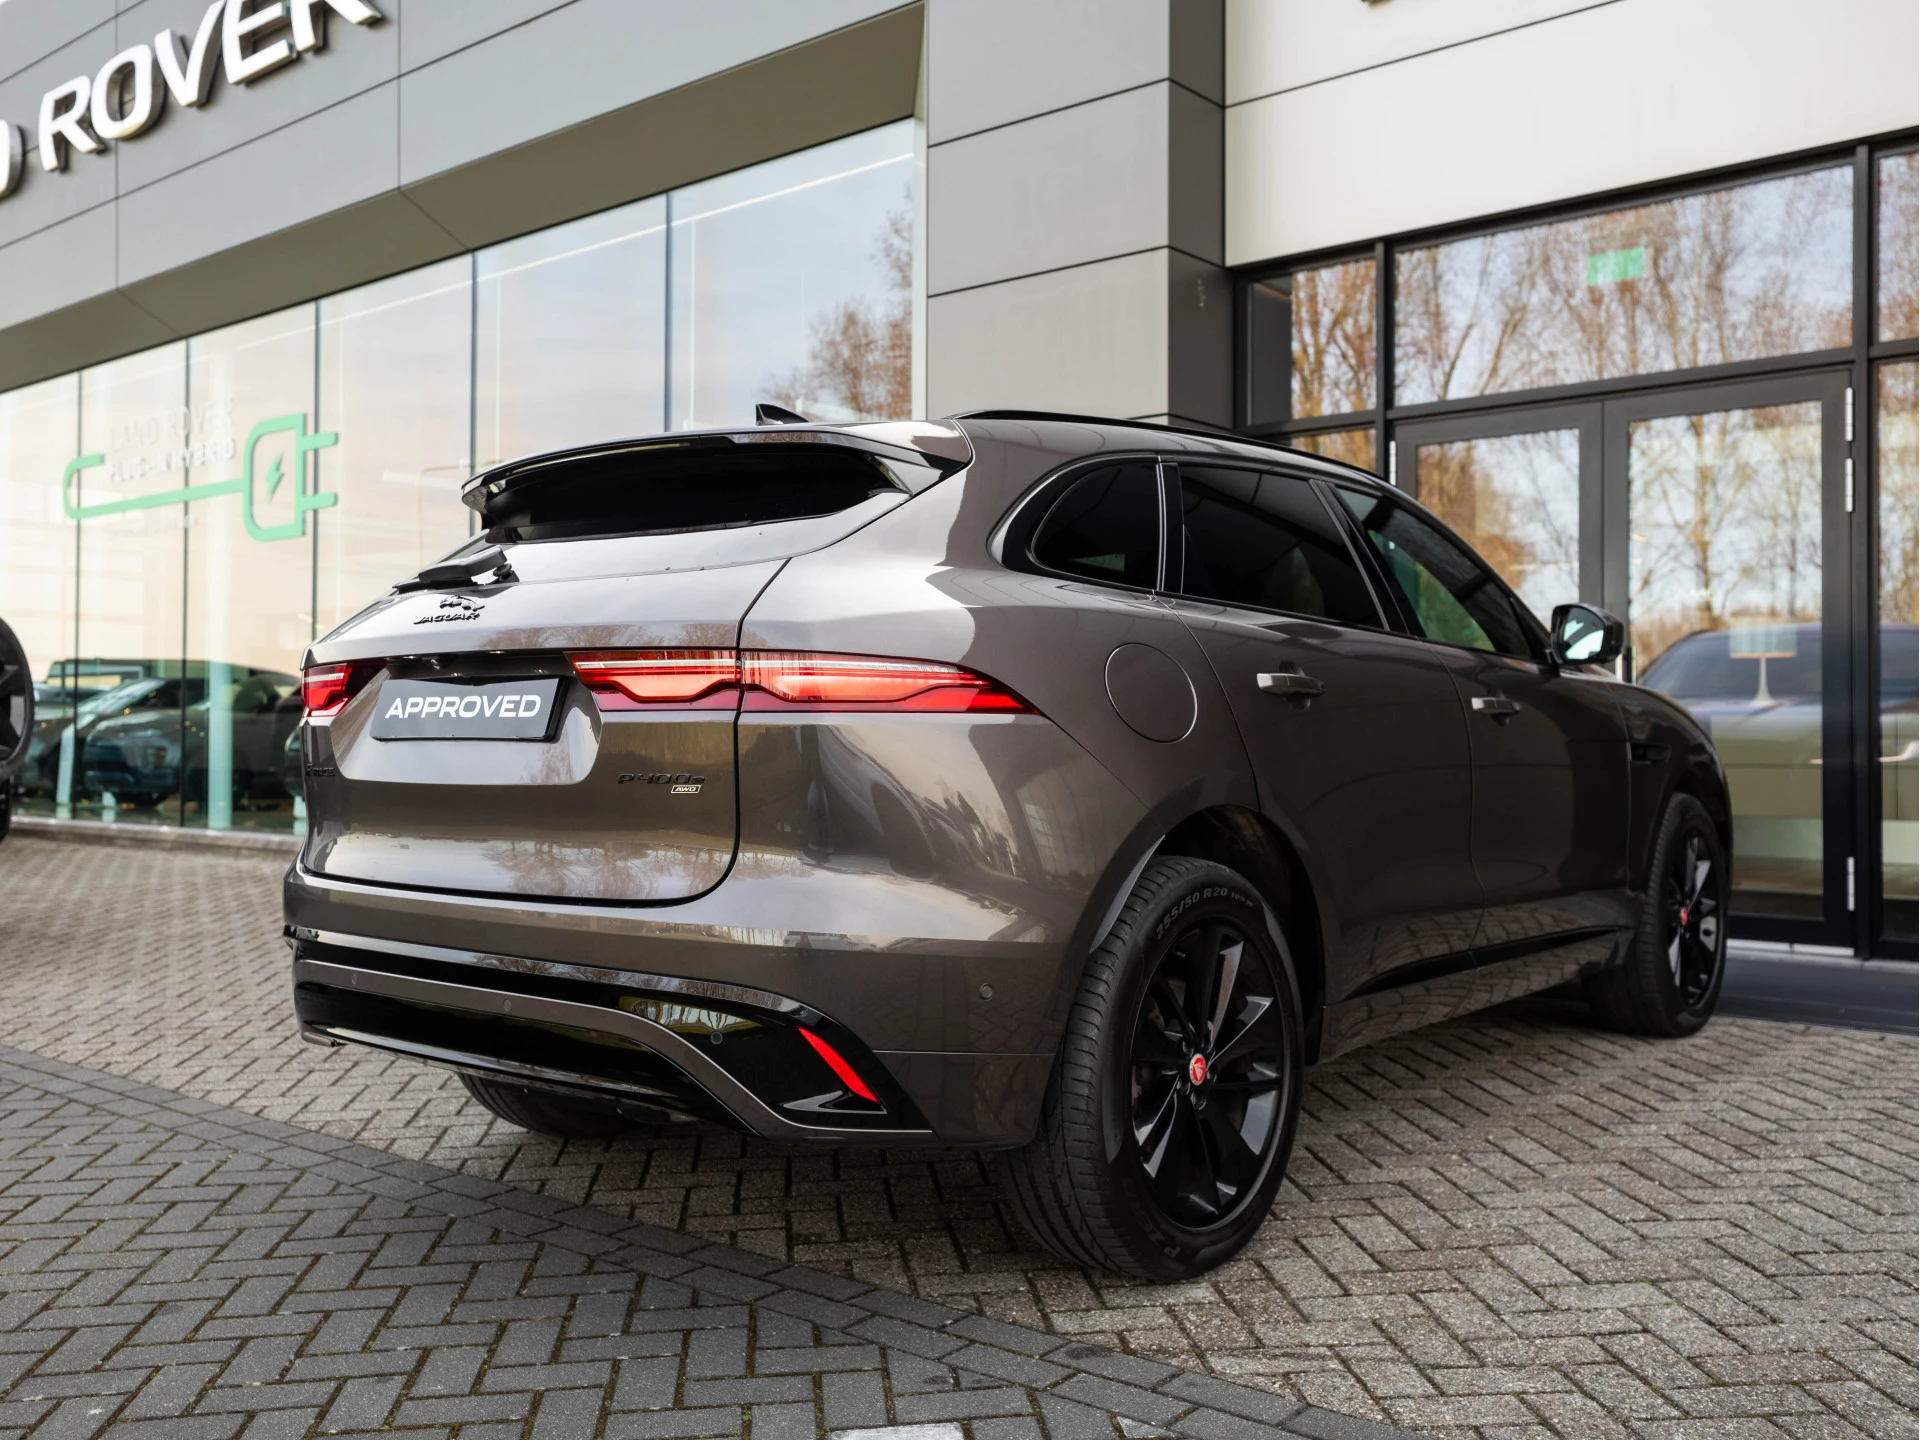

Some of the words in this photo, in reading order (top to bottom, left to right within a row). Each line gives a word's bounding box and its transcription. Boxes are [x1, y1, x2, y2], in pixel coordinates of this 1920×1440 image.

[413, 612, 481, 625] JAGUAR
[384, 693, 541, 719] APPROVED
[617, 773, 706, 784] P400e
[1156, 892, 1200, 940] 255/50
[1203, 887, 1229, 899] R20
